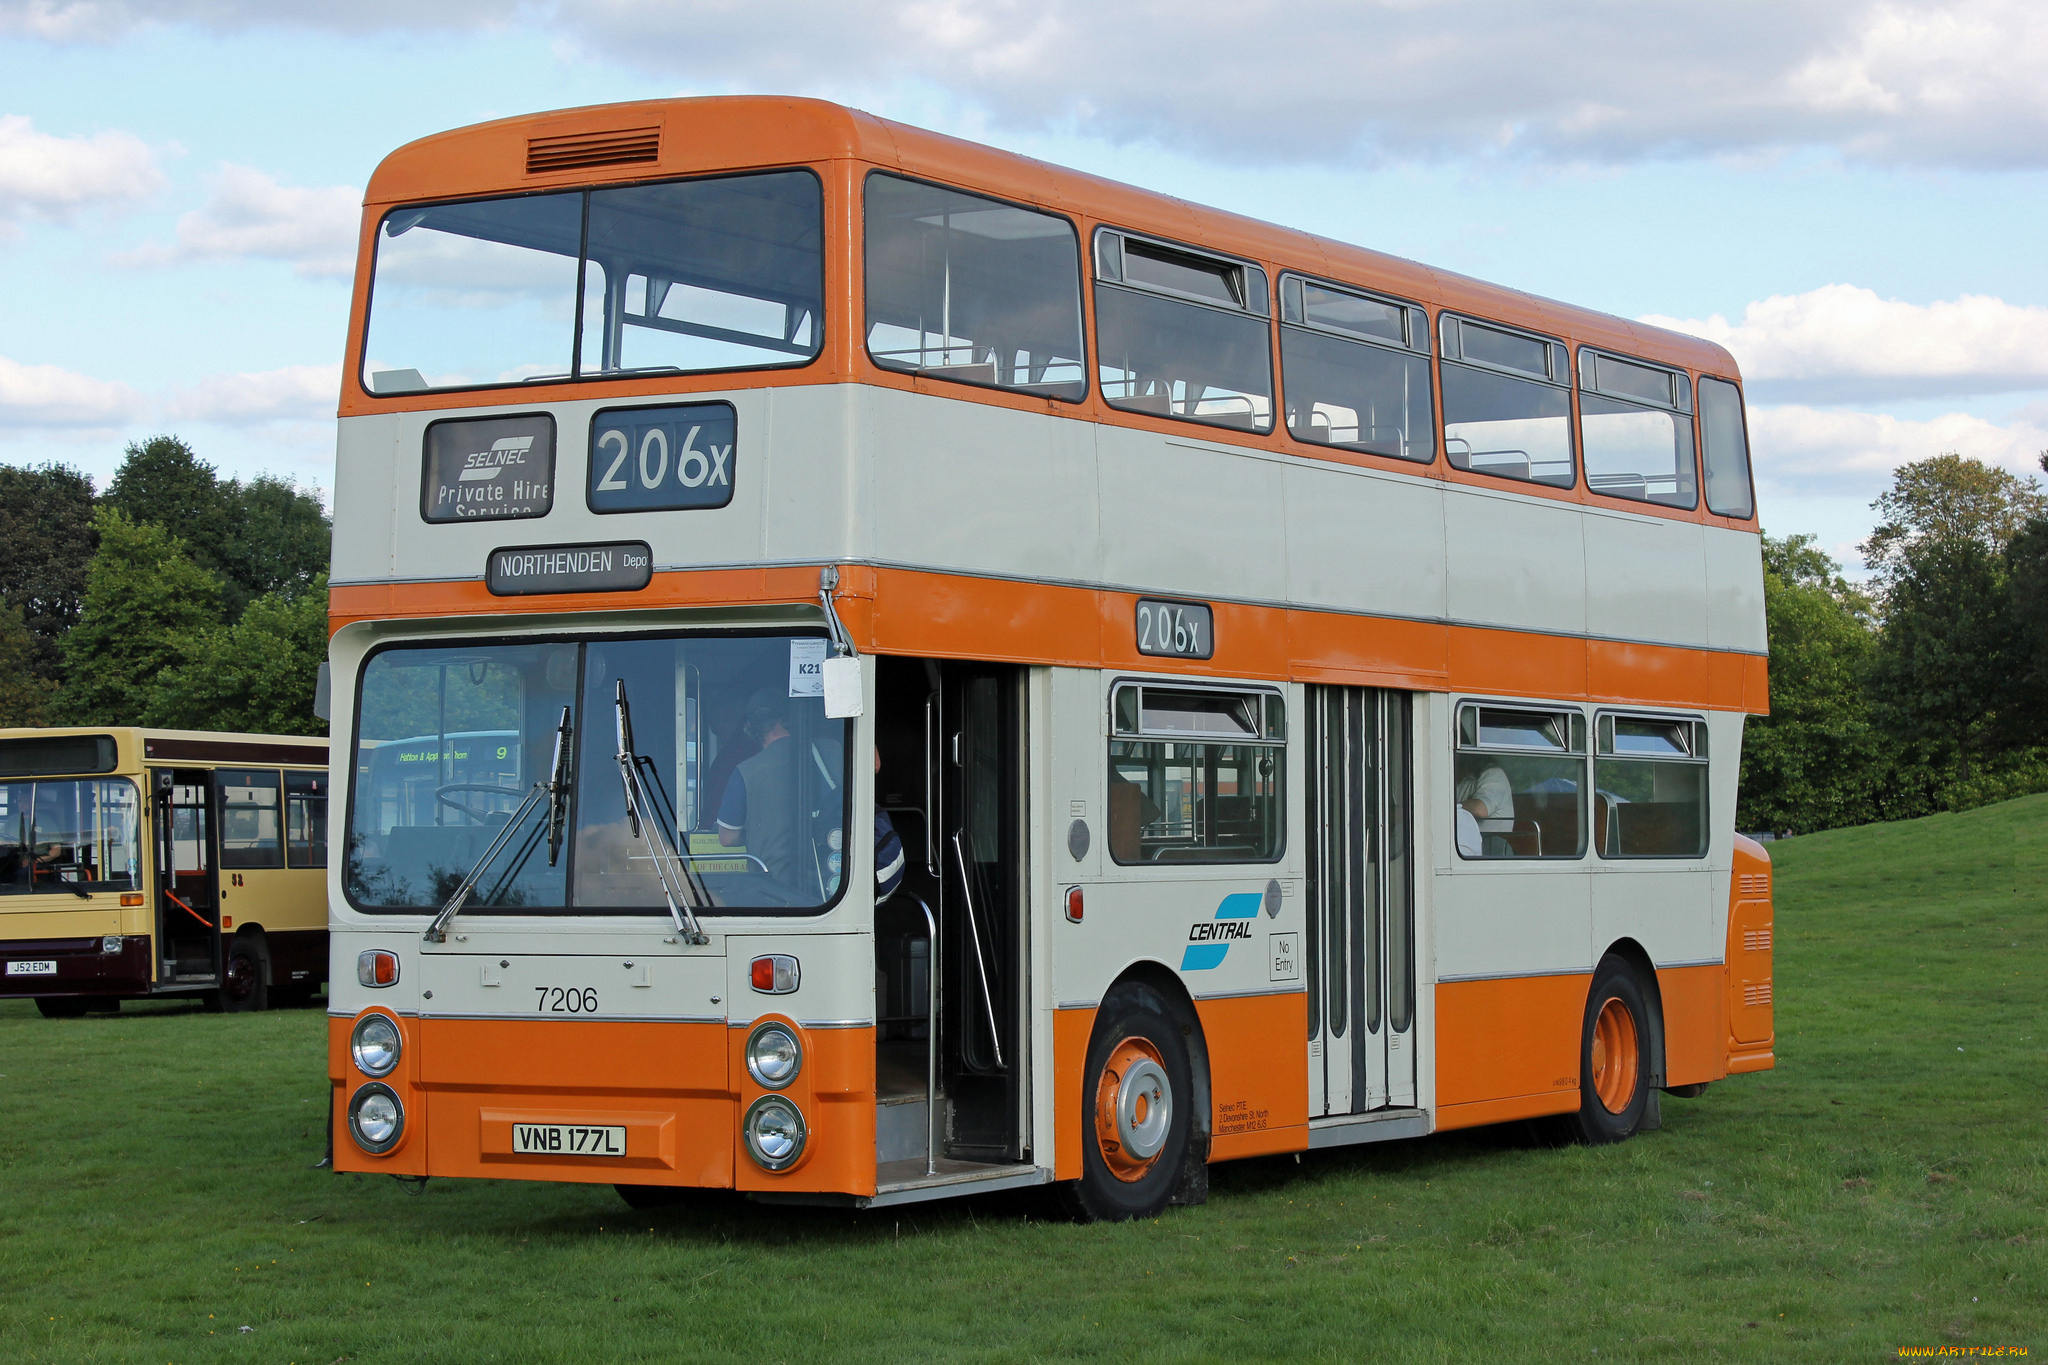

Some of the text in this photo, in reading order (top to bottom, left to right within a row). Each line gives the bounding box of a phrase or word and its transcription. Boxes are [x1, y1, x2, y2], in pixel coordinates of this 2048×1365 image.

[464, 449, 529, 468] SELNEC
[438, 480, 548, 505] Private Hire
[500, 551, 649, 577] NORTHENDEN Depo
[496, 746, 508, 760] 9
[709, 863, 722, 871] THE
[1189, 921, 1252, 941] CENTRAL
[1279, 940, 1290, 954] No
[14, 962, 50, 972] J52 EDM
[1275, 957, 1293, 973] Entry
[535, 986, 598, 1013] 7206
[1256, 1109, 1269, 1118] North
[1219, 1123, 1246, 1133] Manchester
[520, 1127, 619, 1153] VNB 177L
